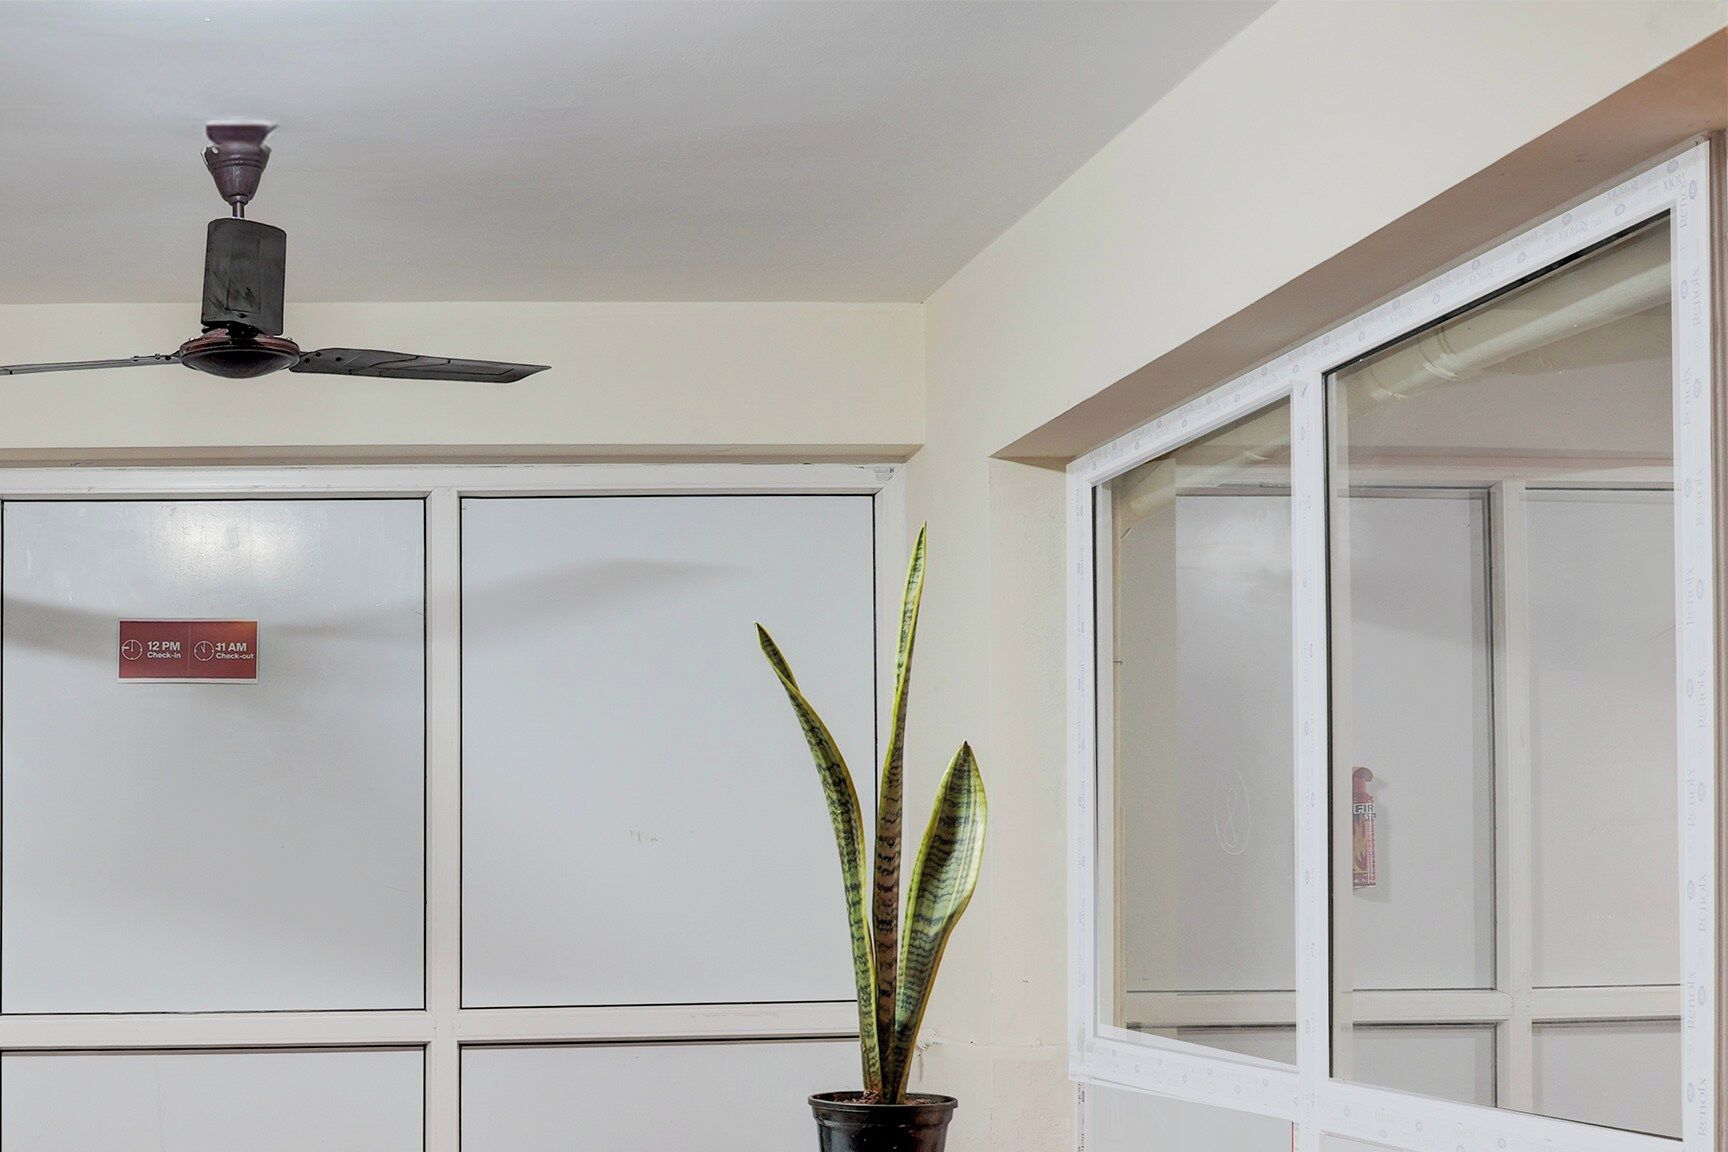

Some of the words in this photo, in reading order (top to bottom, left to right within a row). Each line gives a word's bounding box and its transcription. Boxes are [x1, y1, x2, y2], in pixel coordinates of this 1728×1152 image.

[147, 641, 160, 651] 12
[162, 641, 181, 651] PM
[228, 642, 247, 652] AM
[147, 651, 181, 659] Check-in
[216, 652, 254, 660] Check-out
